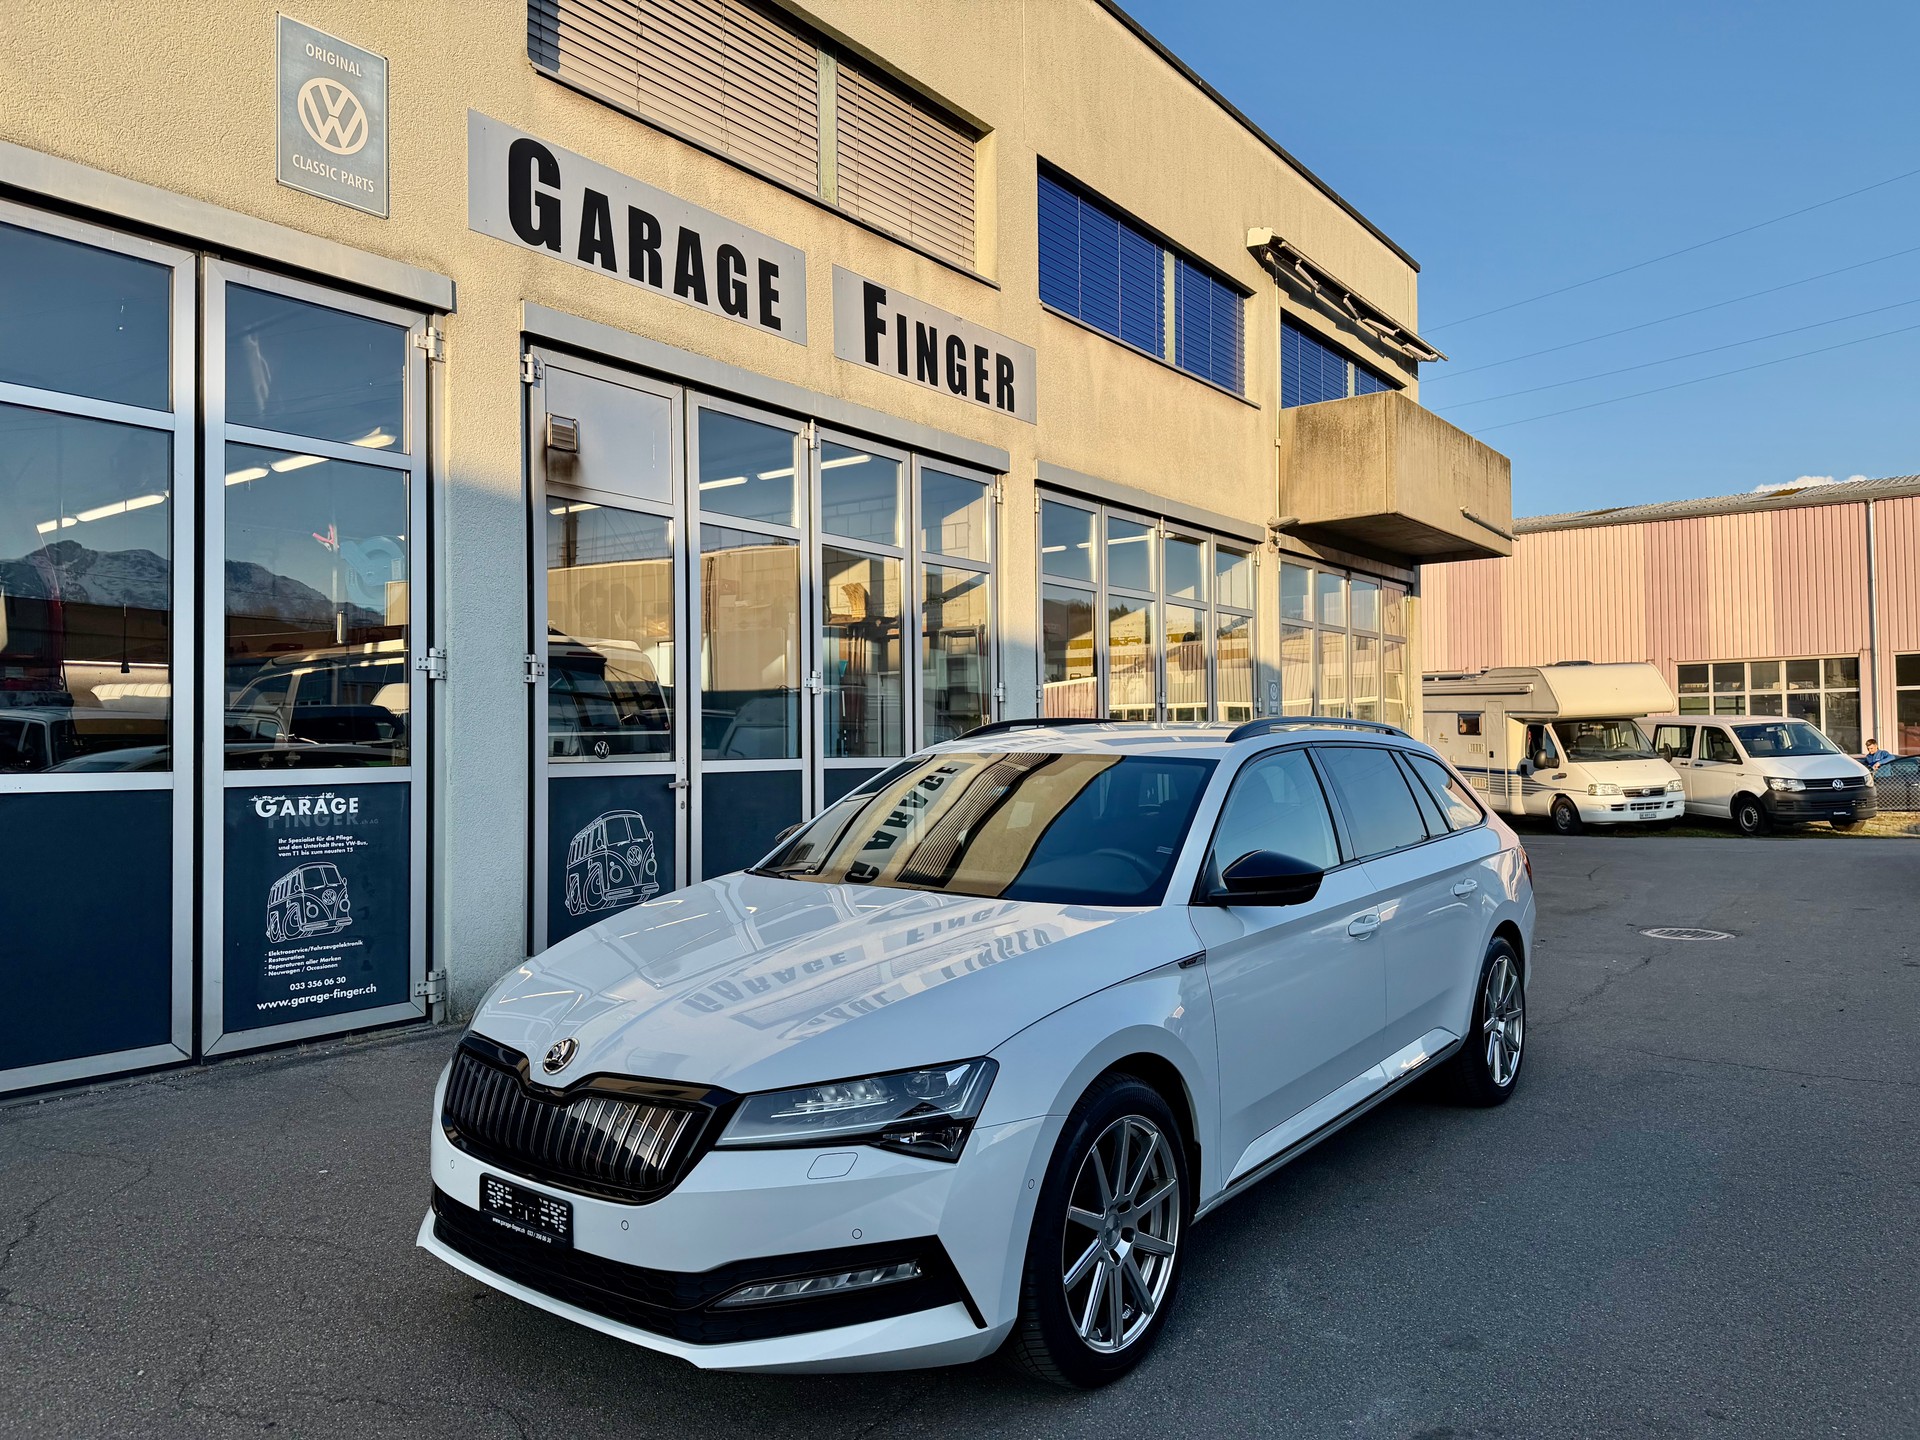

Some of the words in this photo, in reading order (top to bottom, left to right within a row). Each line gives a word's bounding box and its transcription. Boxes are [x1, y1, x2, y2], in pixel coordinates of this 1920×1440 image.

[306, 43, 361, 77] ORIGINAL
[292, 154, 337, 181] CLASSIC
[341, 170, 374, 193] PARTS
[508, 137, 781, 331] GARAGE
[863, 280, 1015, 413] FINGER
[255, 797, 358, 818] GARAGE
[288, 837, 315, 845] Spezialist
[268, 940, 363, 956] Elektroservice/Fahrzeugelektronik
[268, 954, 305, 963] Restauration
[268, 960, 304, 970] Reparaturen
[268, 968, 300, 976] Neuwagen
[306, 963, 338, 972] Occasionen
[290, 982, 306, 990] 033
[307, 980, 322, 988] 356
[324, 978, 334, 986] 06
[257, 984, 376, 1010] www.garage-finger.ch
